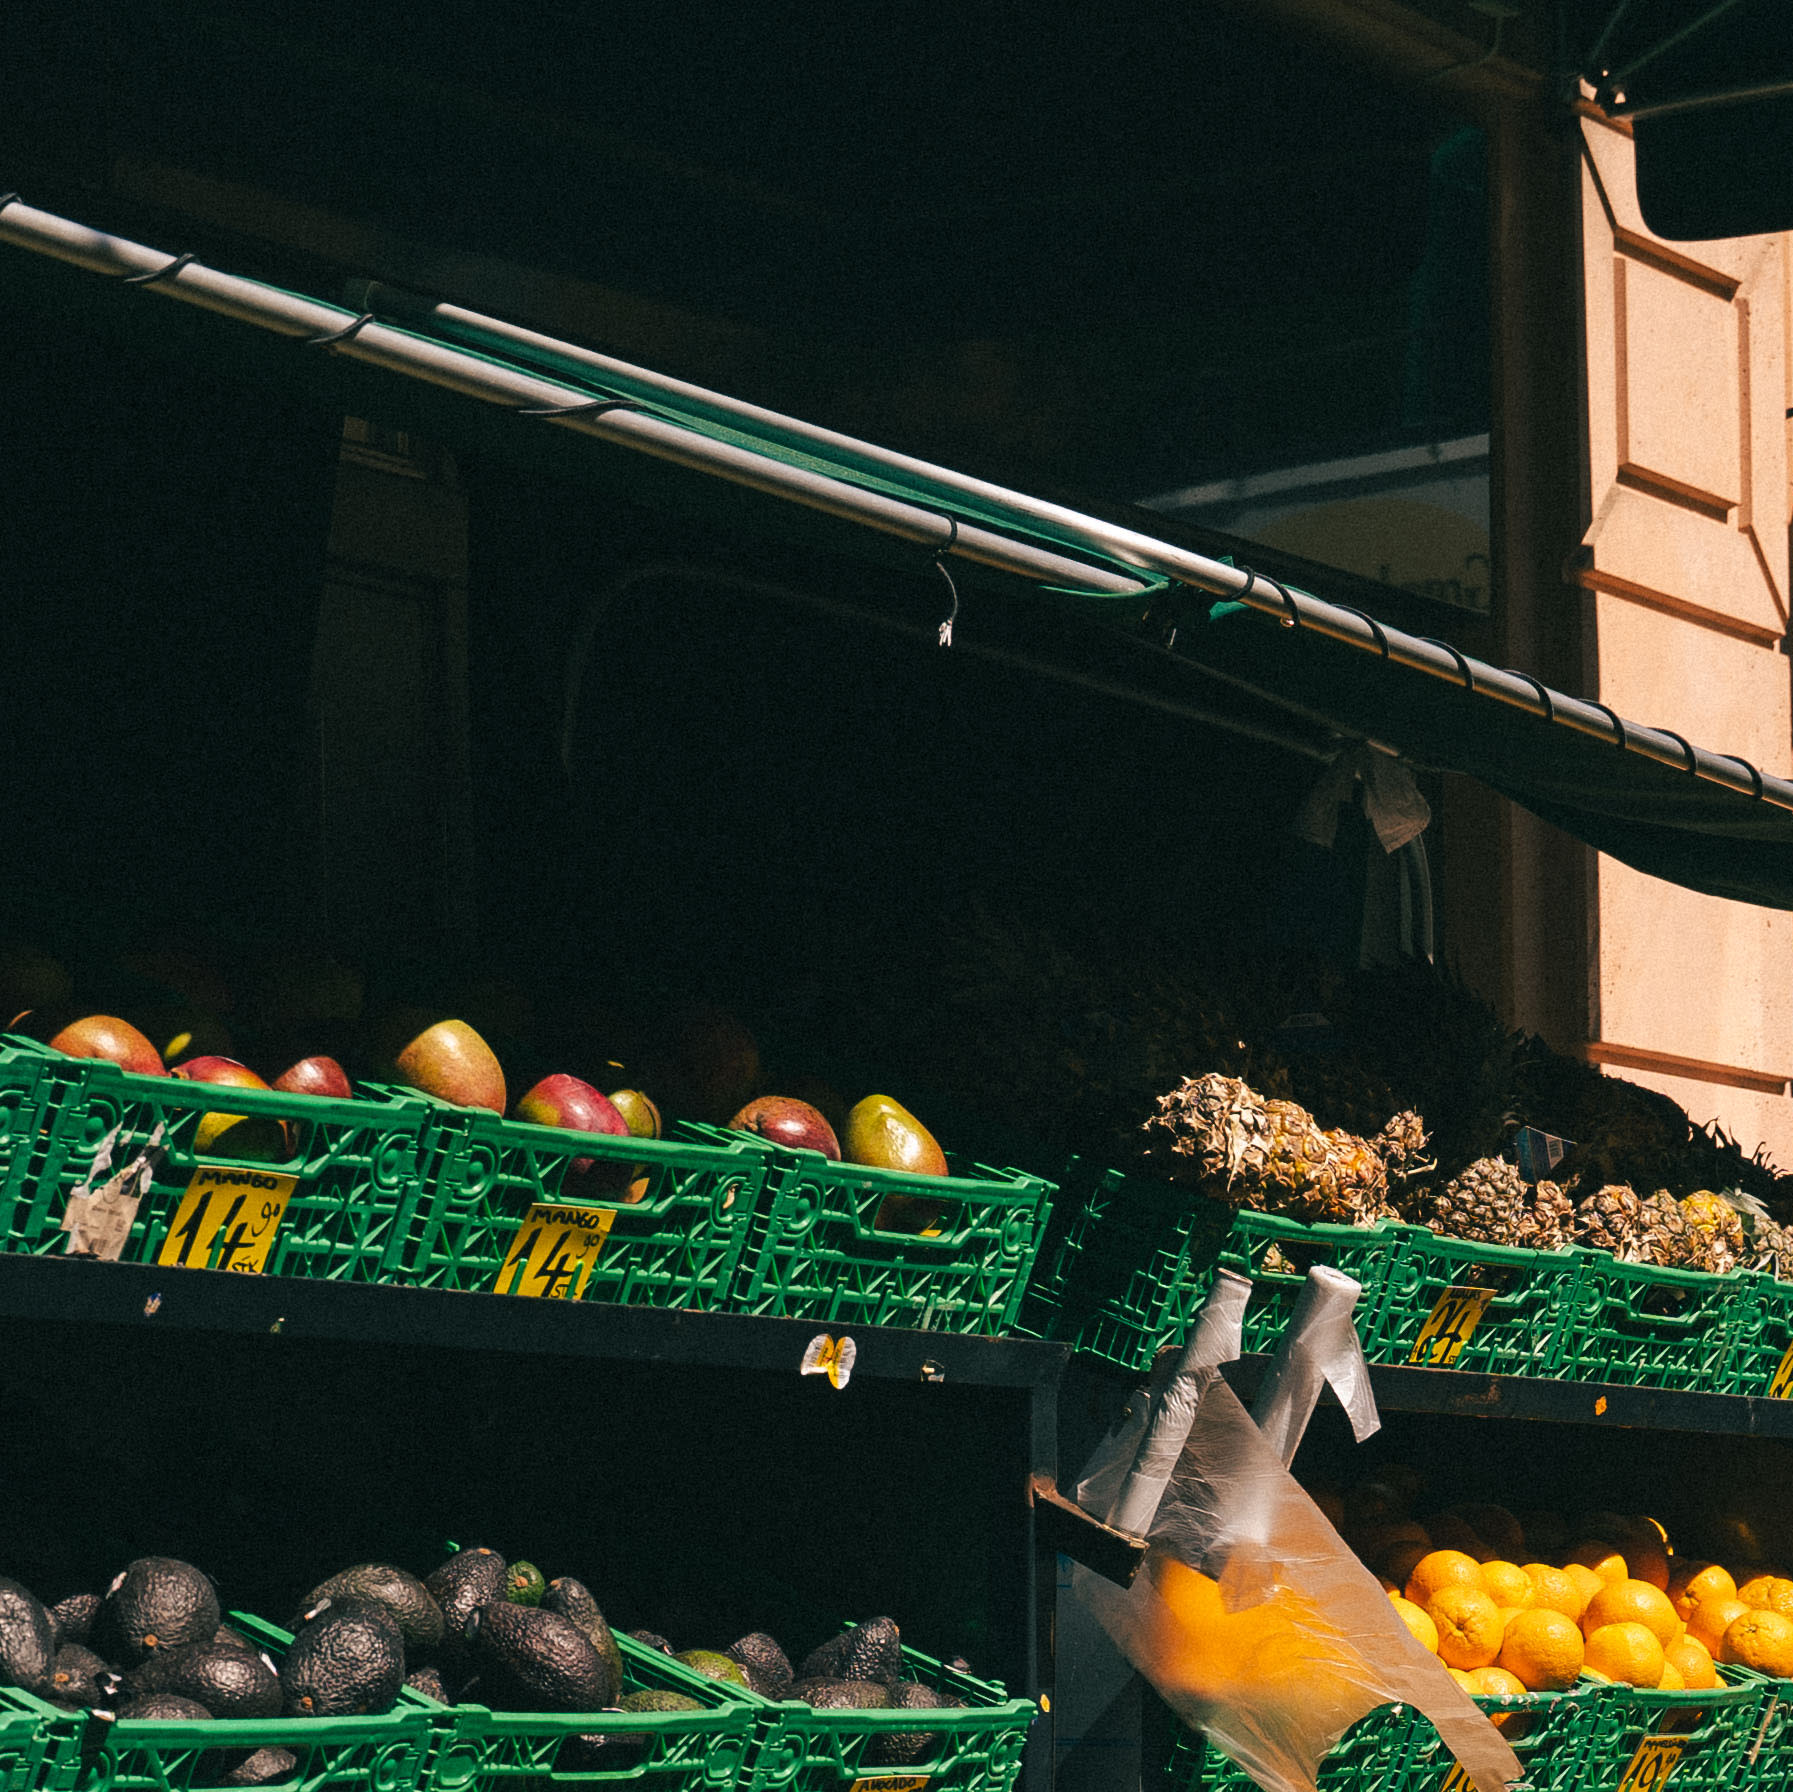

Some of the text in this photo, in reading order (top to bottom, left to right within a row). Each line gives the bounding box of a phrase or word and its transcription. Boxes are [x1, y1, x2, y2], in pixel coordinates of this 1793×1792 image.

[197, 1171, 279, 1190] MANGO
[174, 1190, 256, 1271] 14
[251, 1201, 282, 1237] 90
[530, 1208, 601, 1230] MANGO
[507, 1227, 576, 1298] 14
